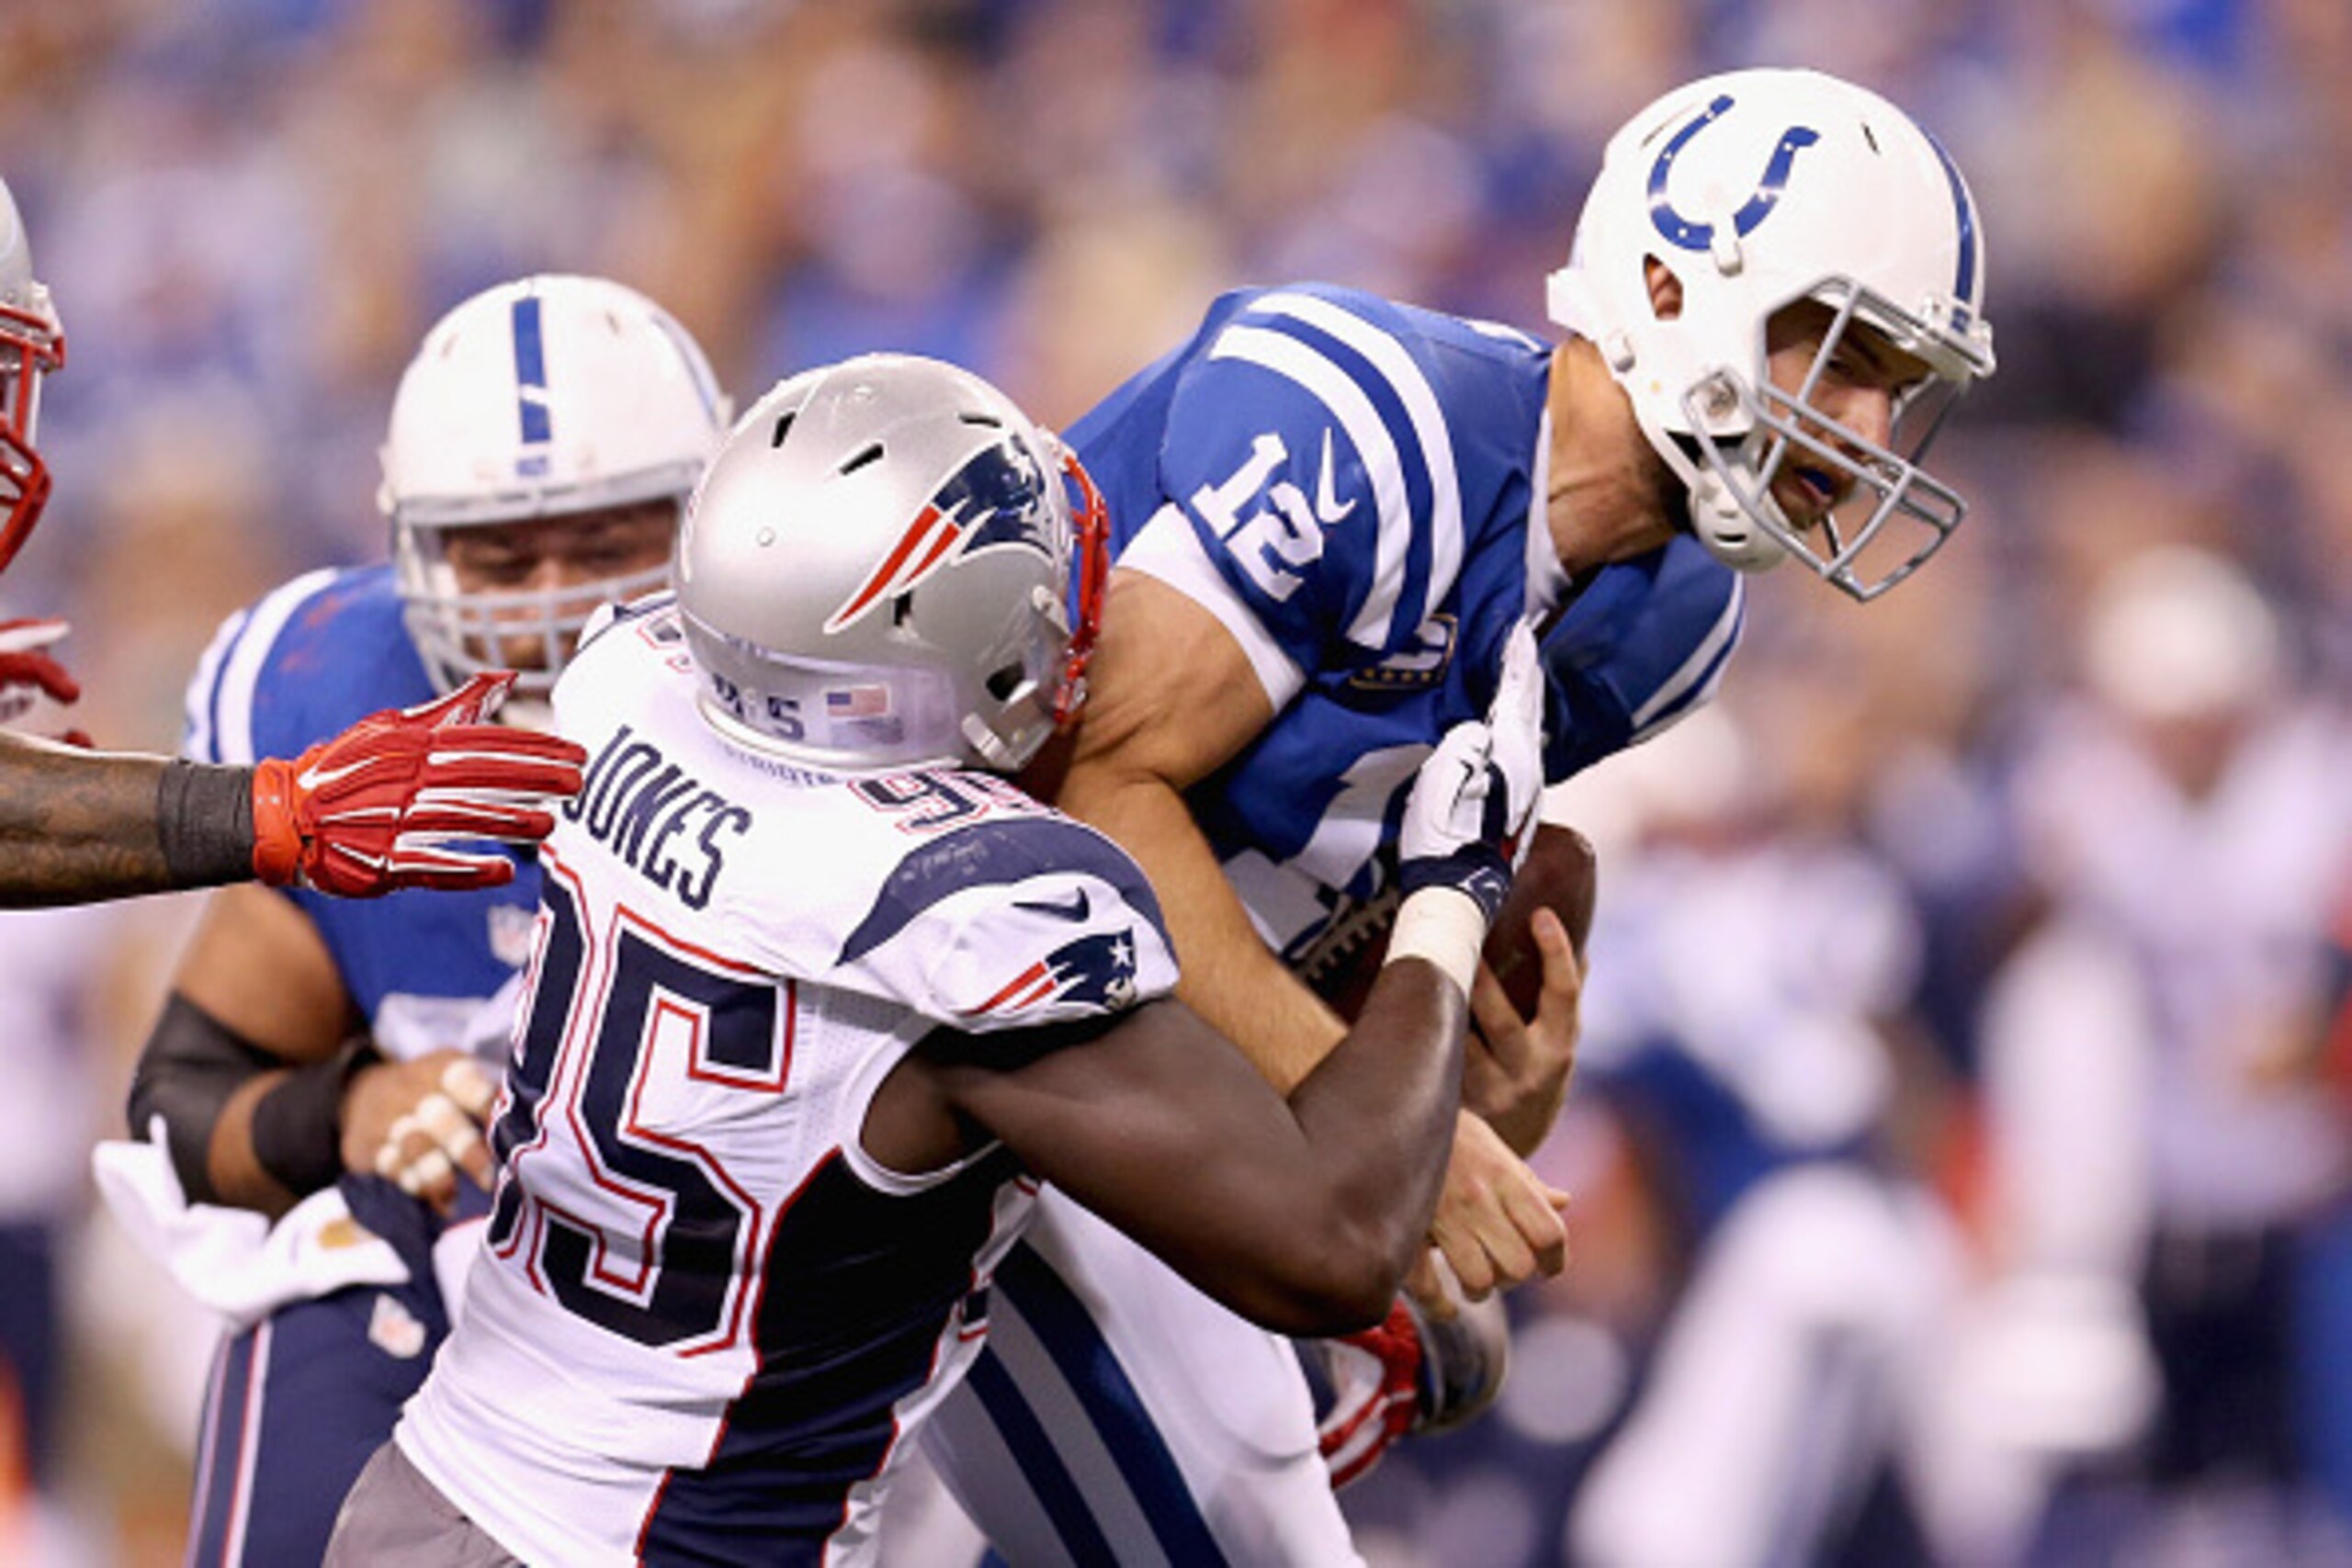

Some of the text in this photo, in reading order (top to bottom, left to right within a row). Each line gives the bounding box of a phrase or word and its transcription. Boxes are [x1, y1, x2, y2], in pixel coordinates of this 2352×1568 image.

[1191, 433, 1324, 603] 12
[561, 724, 752, 911] JONES
[489, 843, 797, 1358] 95
